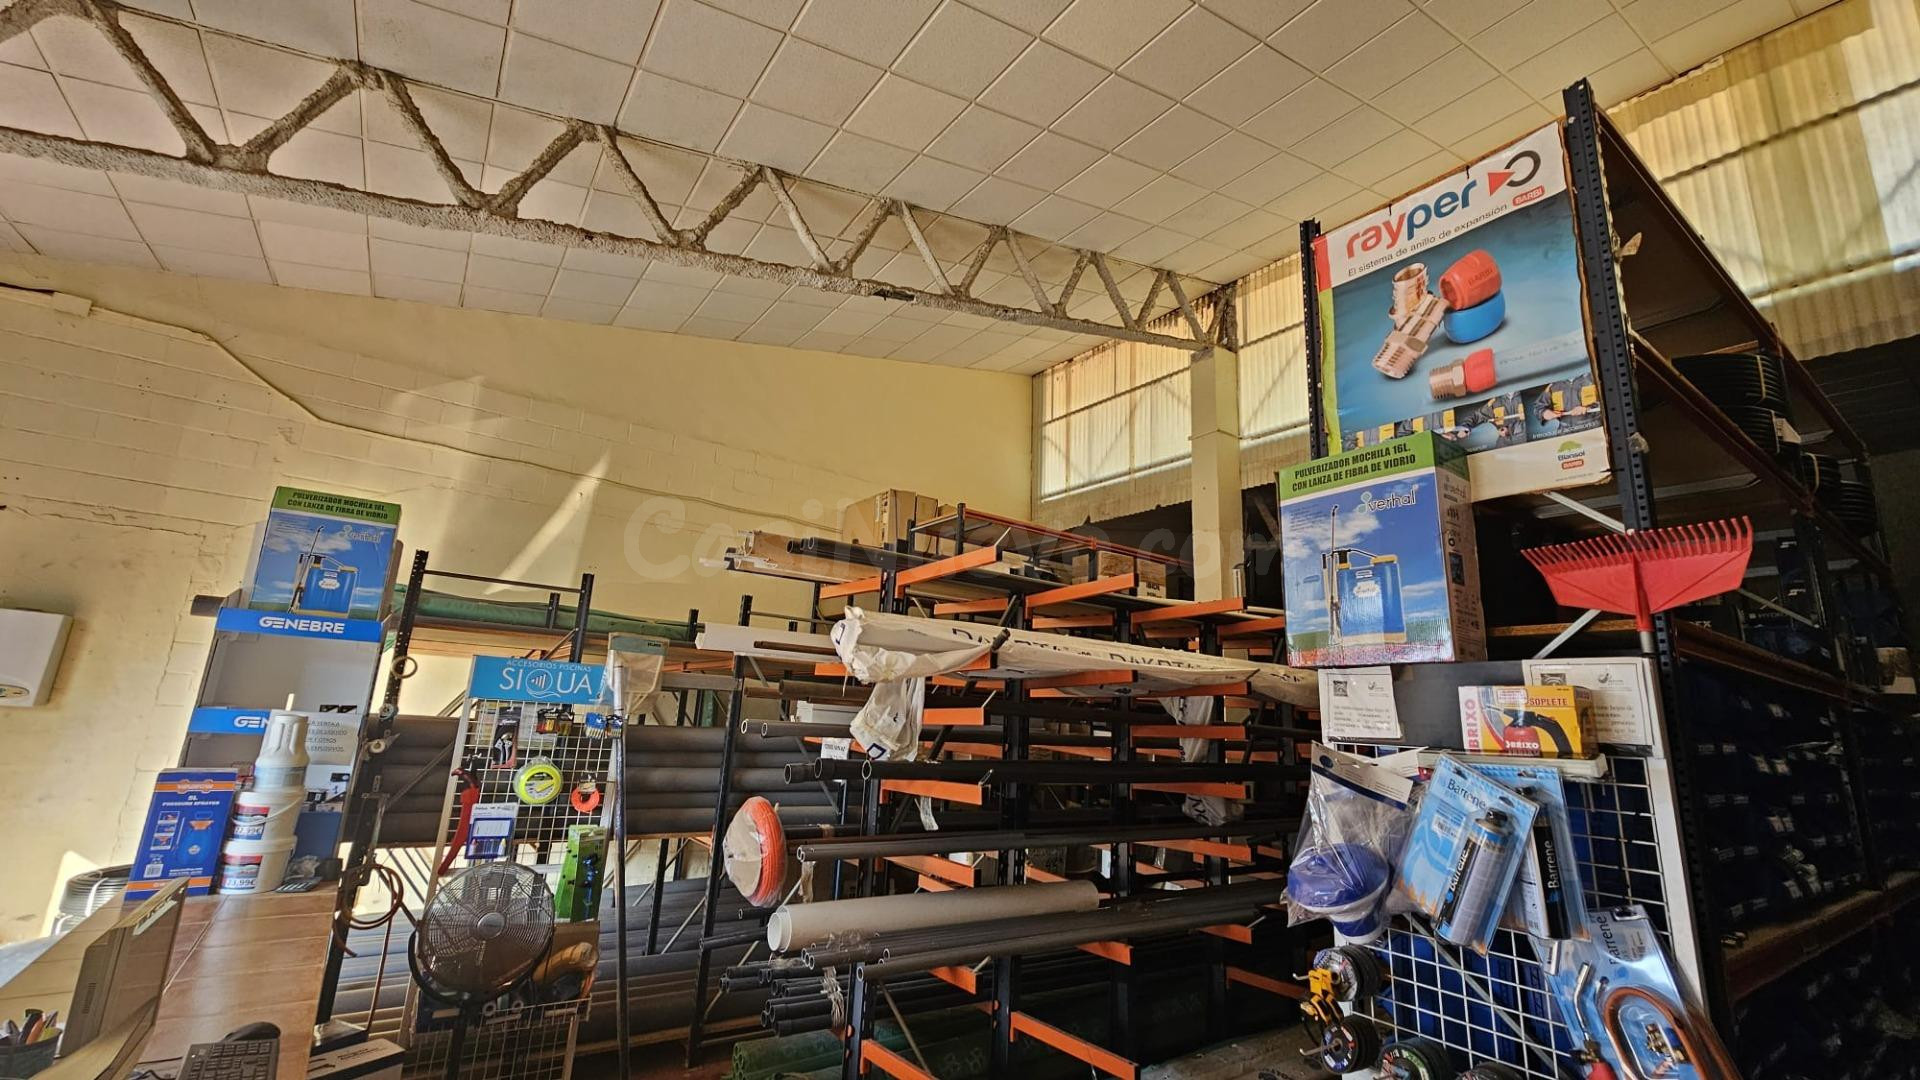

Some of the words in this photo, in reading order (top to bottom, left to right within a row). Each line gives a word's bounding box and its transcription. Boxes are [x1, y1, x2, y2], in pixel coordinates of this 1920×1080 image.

[1513, 188, 1544, 206] BARBI
[1346, 179, 1477, 260] rayper
[1348, 266, 1358, 277] El
[1358, 253, 1395, 274] sistema
[1395, 246, 1409, 258] de
[1409, 235, 1437, 251] anillo
[1438, 228, 1453, 240] de
[1453, 201, 1509, 235] expansión
[1292, 479, 1307, 492] CON
[1308, 474, 1332, 488] LANZA
[1333, 471, 1344, 482] DE
[1344, 466, 1370, 479] FIBRA
[1371, 463, 1382, 474] DE
[1383, 454, 1417, 471] VIDRIO
[1294, 454, 1351, 479] PULVERIZADOR
[1352, 447, 1391, 466] MOCHILA
[1392, 443, 1411, 457] 16L.
[287, 499, 302, 508] CON
[303, 501, 325, 511] LANZA
[325, 505, 334, 513] DE
[335, 506, 355, 515] FIBRA
[356, 509, 364, 517] DE
[365, 511, 388, 520] VIDRIO
[292, 491, 343, 506] PULVERIZADOR
[343, 499, 374, 510] MOCHILA
[259, 615, 345, 635] GENEBRE
[506, 659, 558, 670] ACCESORIOS
[558, 663, 592, 673] PISCINAS
[499, 667, 592, 698] SIQUA
[1464, 699, 1480, 749] BRIXO
[1447, 779, 1487, 811] Barrene
[1547, 840, 1559, 890] Barrene
